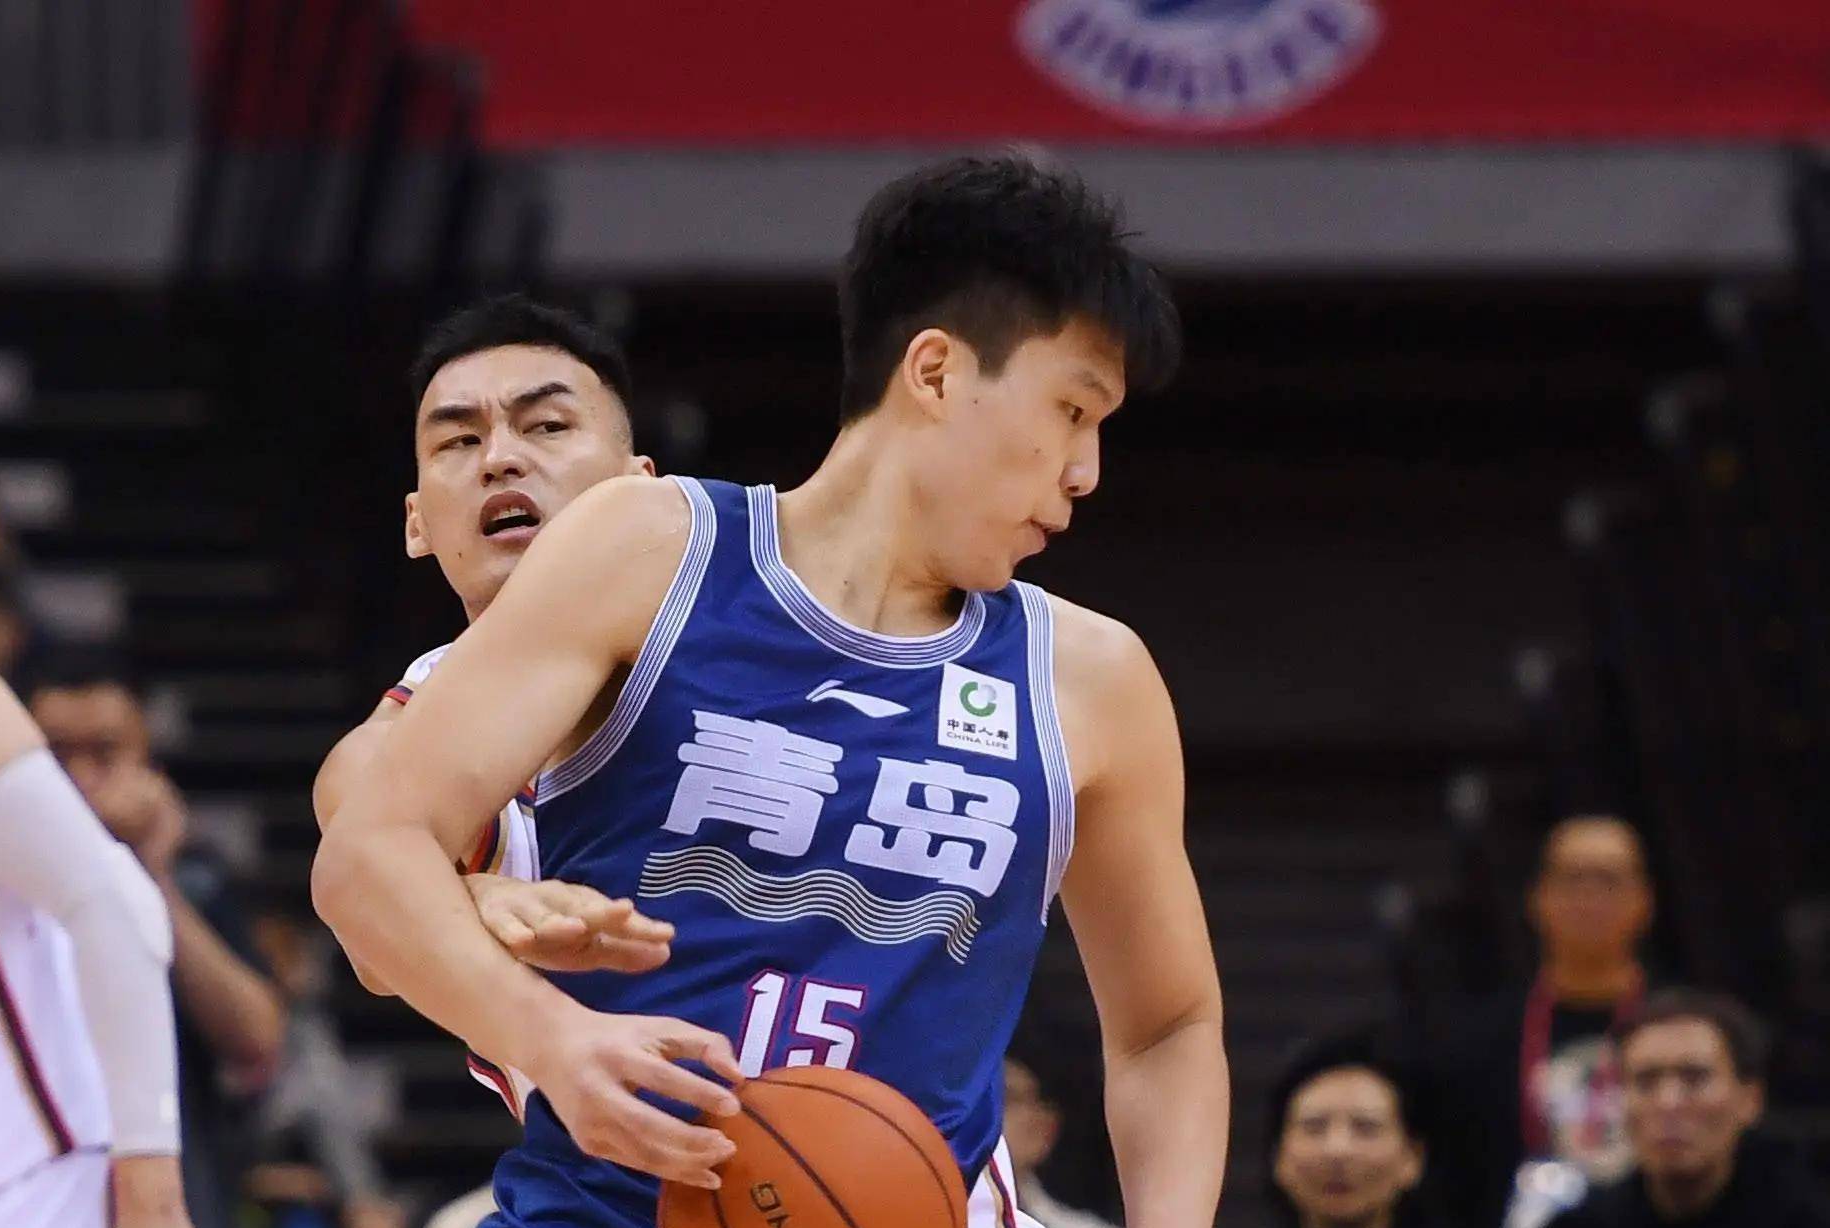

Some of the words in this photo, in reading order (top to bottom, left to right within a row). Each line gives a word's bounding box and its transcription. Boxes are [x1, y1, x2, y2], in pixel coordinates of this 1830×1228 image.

[946, 731, 982, 744] CHINA
[985, 739, 1009, 749] LIFE
[947, 719, 1009, 740] 中国人寿
[660, 709, 1021, 897] 青岛
[736, 970, 867, 1080] 15
